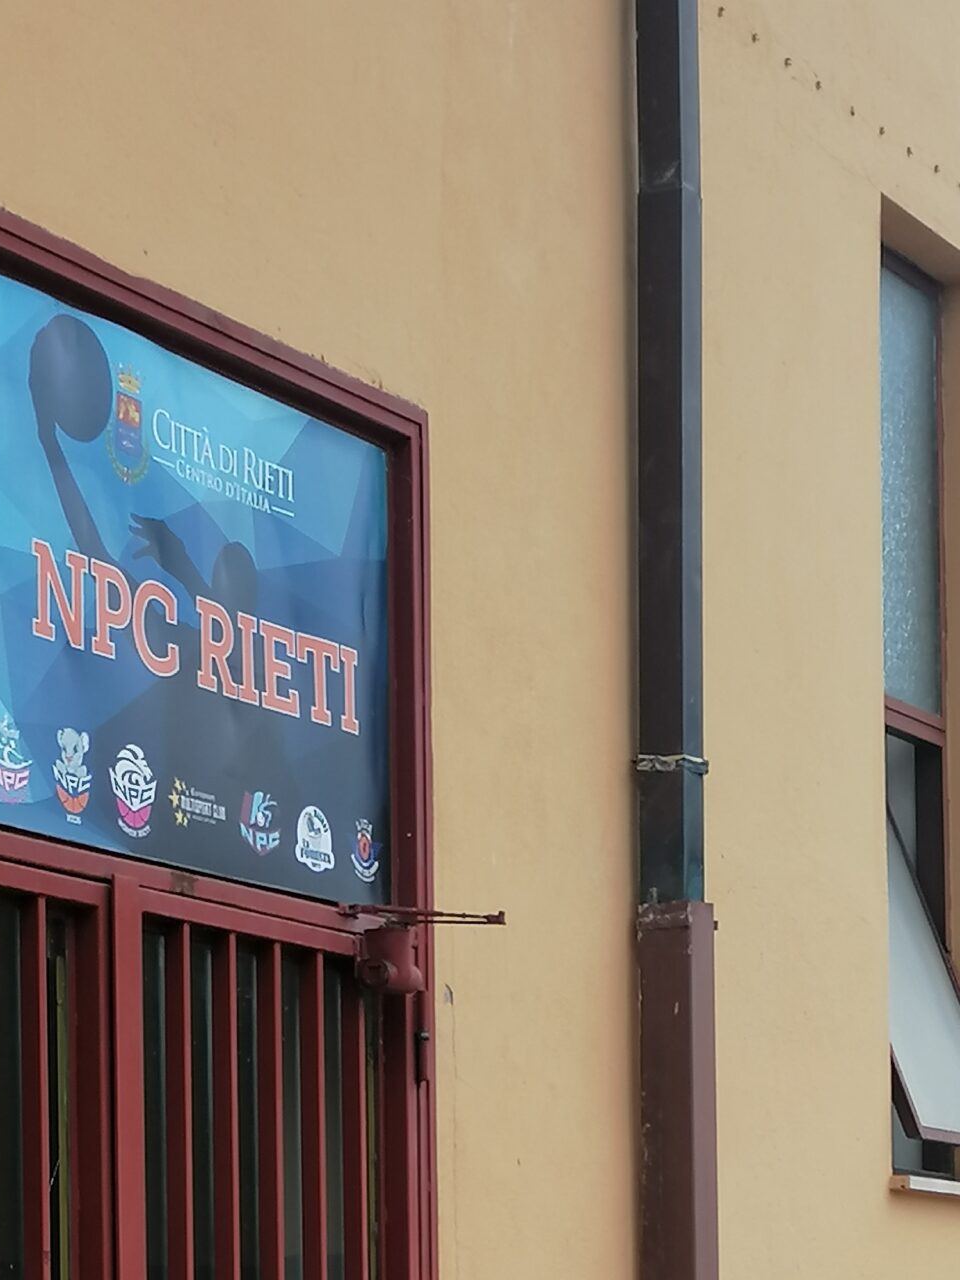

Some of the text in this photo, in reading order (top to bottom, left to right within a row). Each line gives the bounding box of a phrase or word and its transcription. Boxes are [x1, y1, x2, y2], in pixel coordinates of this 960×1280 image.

[175, 458, 272, 514] CENTRO D'ITALIA
[243, 447, 295, 503] RIETI
[32, 537, 360, 736] NPC RIETI
[53, 764, 93, 796] NPC
[112, 774, 156, 808] NPC
[239, 822, 281, 851] NPC
